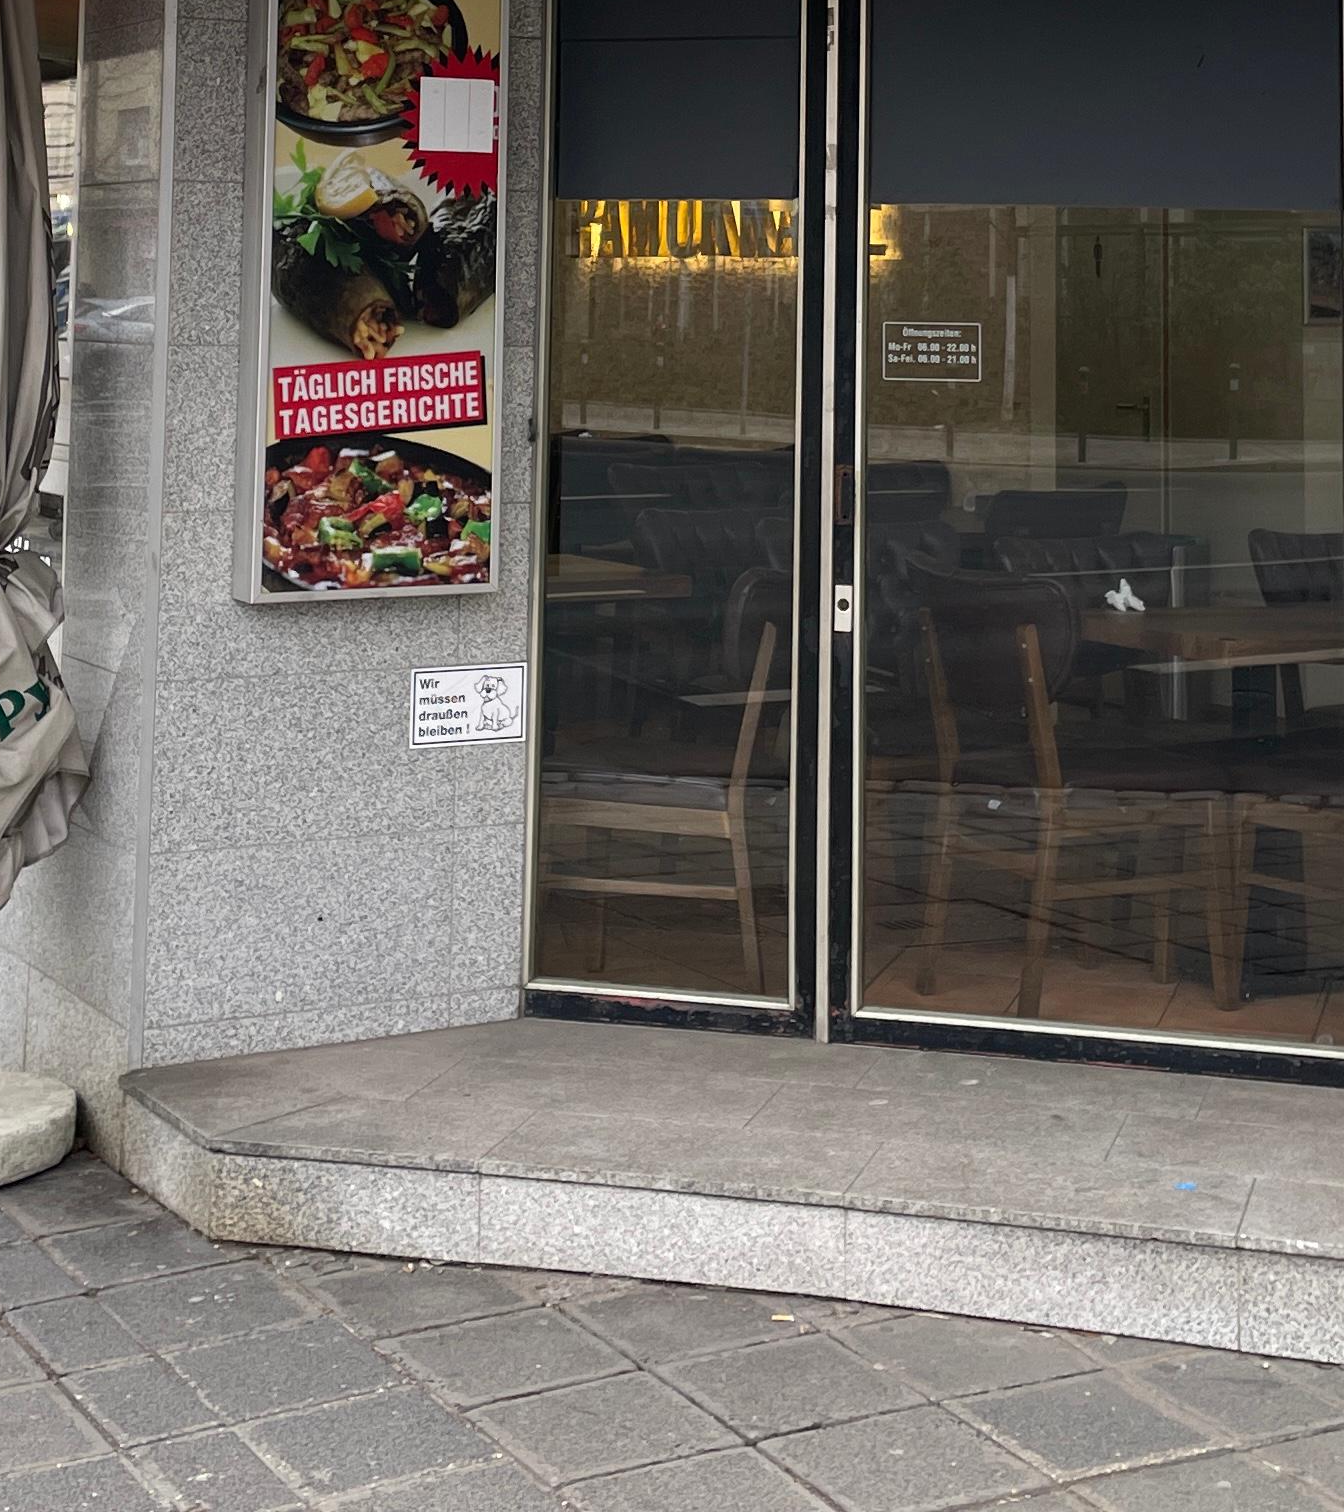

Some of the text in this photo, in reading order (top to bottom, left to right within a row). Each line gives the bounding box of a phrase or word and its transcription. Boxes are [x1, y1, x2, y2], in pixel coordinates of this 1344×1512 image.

[277, 360, 479, 403] TÄGLICH FRISCHE
[278, 392, 480, 436] TAGESGERICHTE
[419, 678, 440, 690] Wir
[419, 694, 466, 706] müssen
[418, 709, 468, 721] draußen
[418, 725, 463, 738] bleiben
